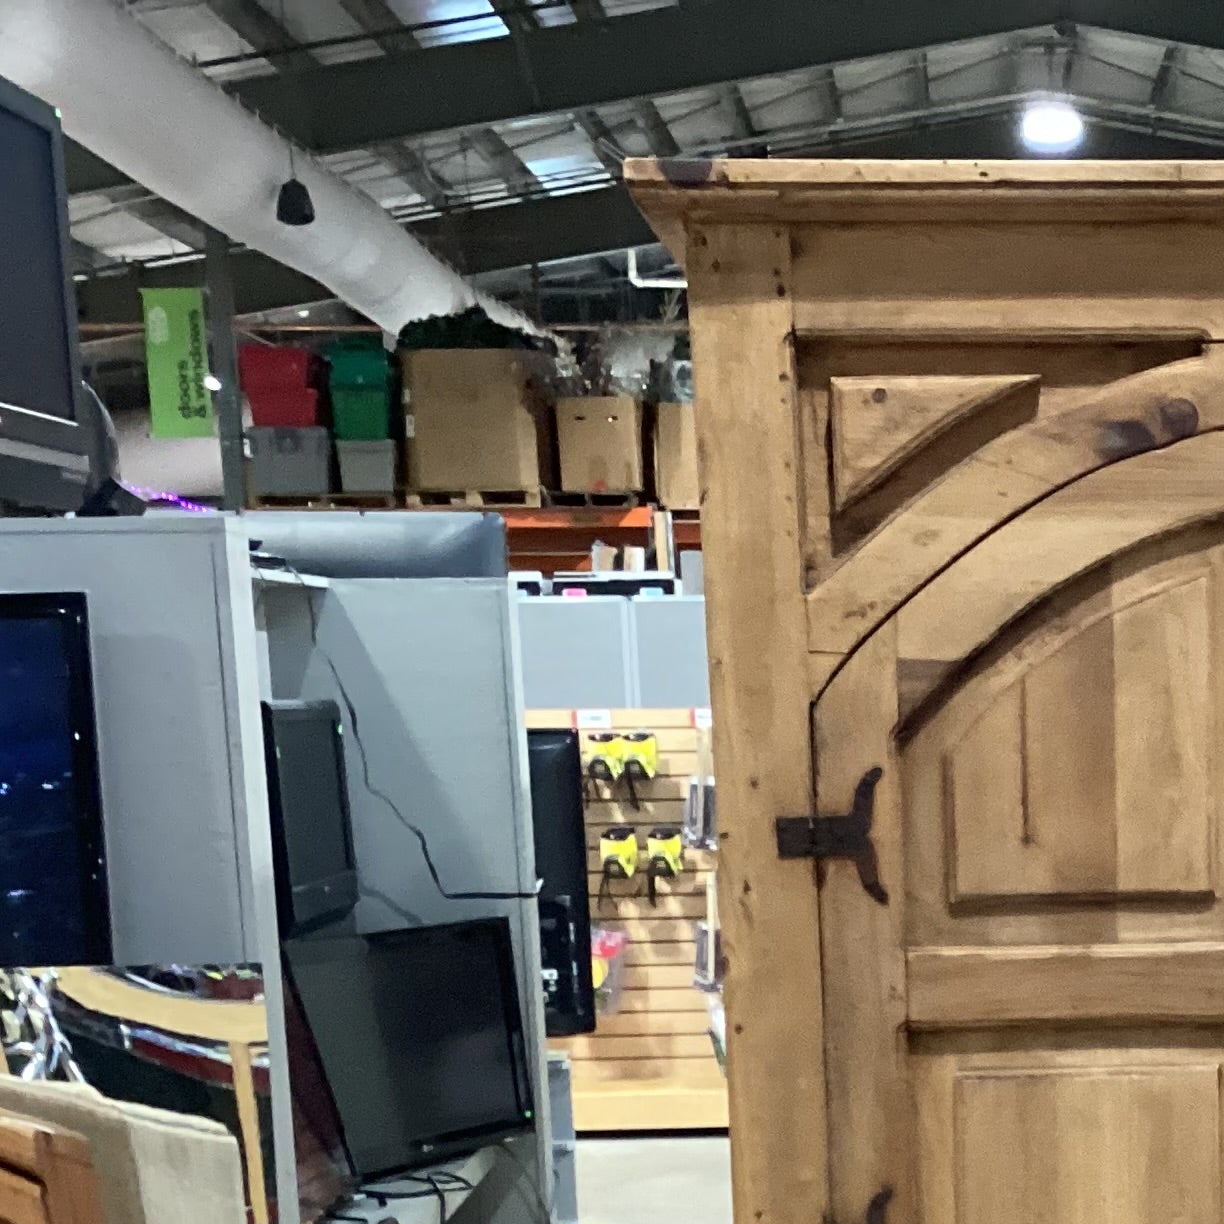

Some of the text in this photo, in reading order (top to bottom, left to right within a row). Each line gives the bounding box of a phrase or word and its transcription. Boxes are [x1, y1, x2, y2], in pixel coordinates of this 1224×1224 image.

[177, 360, 191, 419] doors
[188, 309, 207, 418] & windows
